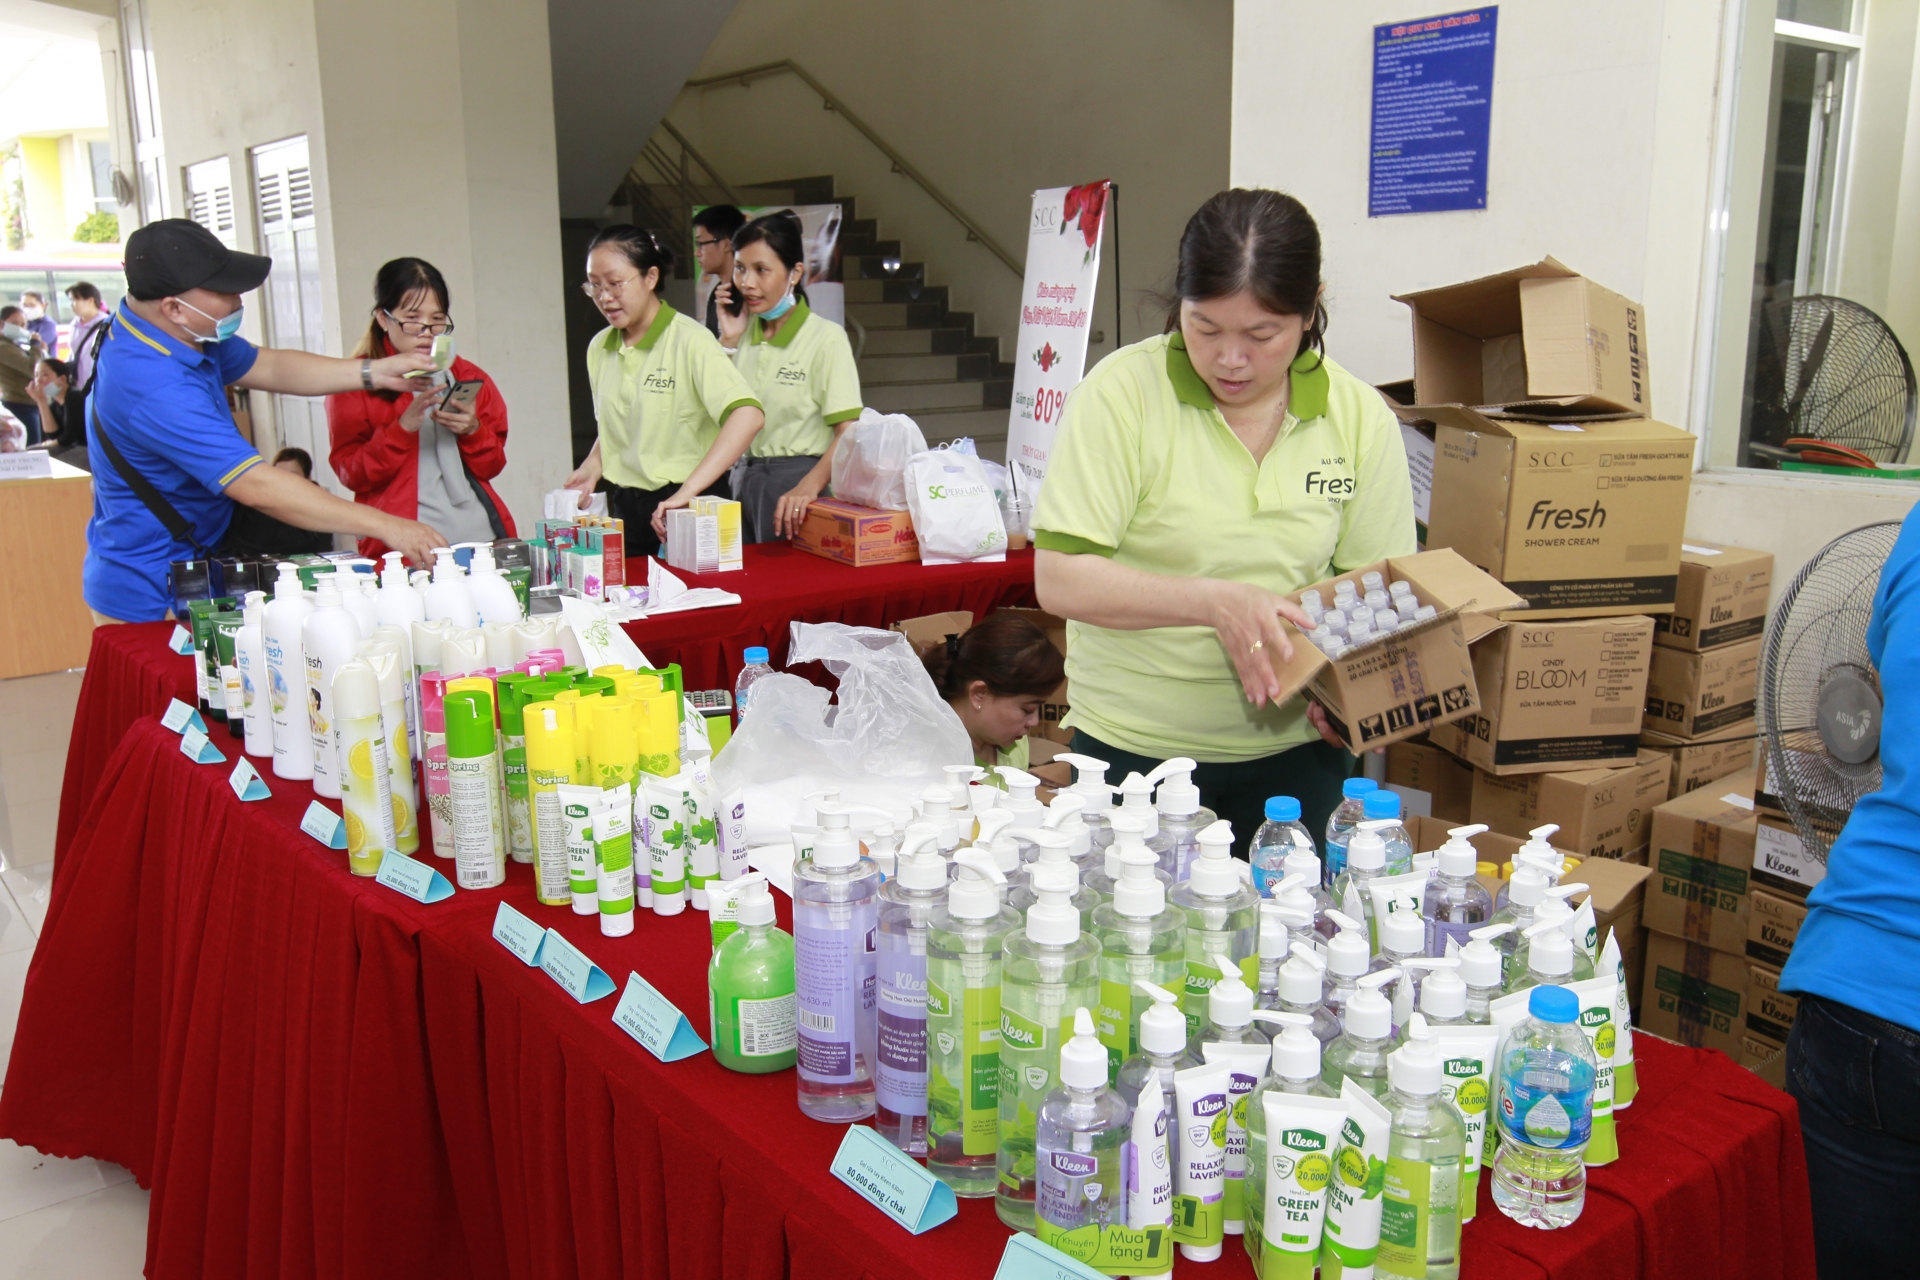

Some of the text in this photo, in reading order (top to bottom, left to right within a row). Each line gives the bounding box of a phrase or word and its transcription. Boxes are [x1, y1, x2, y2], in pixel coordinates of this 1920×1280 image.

[1034, 206, 1057, 227] SCC
[643, 374, 676, 390] Fresh
[1529, 451, 1574, 468] SCC
[1526, 499, 1607, 531] Fresh
[1525, 538, 1600, 547] SHOWER CREAM
[1709, 605, 1733, 624] Kleen
[1521, 631, 1555, 643] SCC
[1541, 659, 1566, 667] CINDY
[1516, 669, 1587, 690] BLOOM
[1701, 692, 1725, 711] Kleen
[1835, 711, 1855, 727] ASIA
[449, 760, 480, 772] Spring
[536, 774, 569, 785] Spring
[1593, 786, 1617, 804] SCC
[566, 805, 587, 817] Kleen
[652, 805, 667, 818] Kleen
[1759, 826, 1788, 844] SCC
[567, 846, 590, 855] GREEN
[570, 854, 584, 862] TEA
[651, 853, 663, 863] TEA
[1765, 853, 1801, 878] Kleen
[1755, 899, 1783, 916] SCC
[895, 971, 927, 991] Klee
[807, 995, 832, 1007] 630 ml
[1583, 1011, 1609, 1025] Kleen
[647, 1034, 659, 1048] chai
[1597, 1040, 1615, 1051] 20,000
[1448, 1060, 1479, 1075] Kleen
[1229, 1077, 1253, 1090] leen
[1197, 1099, 1224, 1115] Kleen
[1460, 1095, 1487, 1106] 20,000đ
[1287, 1131, 1321, 1149] Kleen
[880, 1155, 897, 1171] SCC
[1055, 1153, 1090, 1173] Kleen
[1190, 1156, 1224, 1170] RELAXIN
[873, 1169, 881, 1179] tay
[1189, 1167, 1225, 1180] LAVEND
[1297, 1170, 1329, 1182] 20,000đ
[846, 1166, 868, 1187] 80,000
[867, 1182, 885, 1203] đồng
[889, 1199, 907, 1216] chai
[1041, 1193, 1082, 1214] RELAXING
[1277, 1195, 1319, 1210] GREEN
[1041, 1202, 1085, 1222] LAVENDER
[1286, 1209, 1310, 1222] TEA
[1062, 1235, 1095, 1248] Khuyến
[1109, 1230, 1144, 1244] Mua
[1145, 1229, 1163, 1258] 1
[1109, 1245, 1143, 1261] tặng
